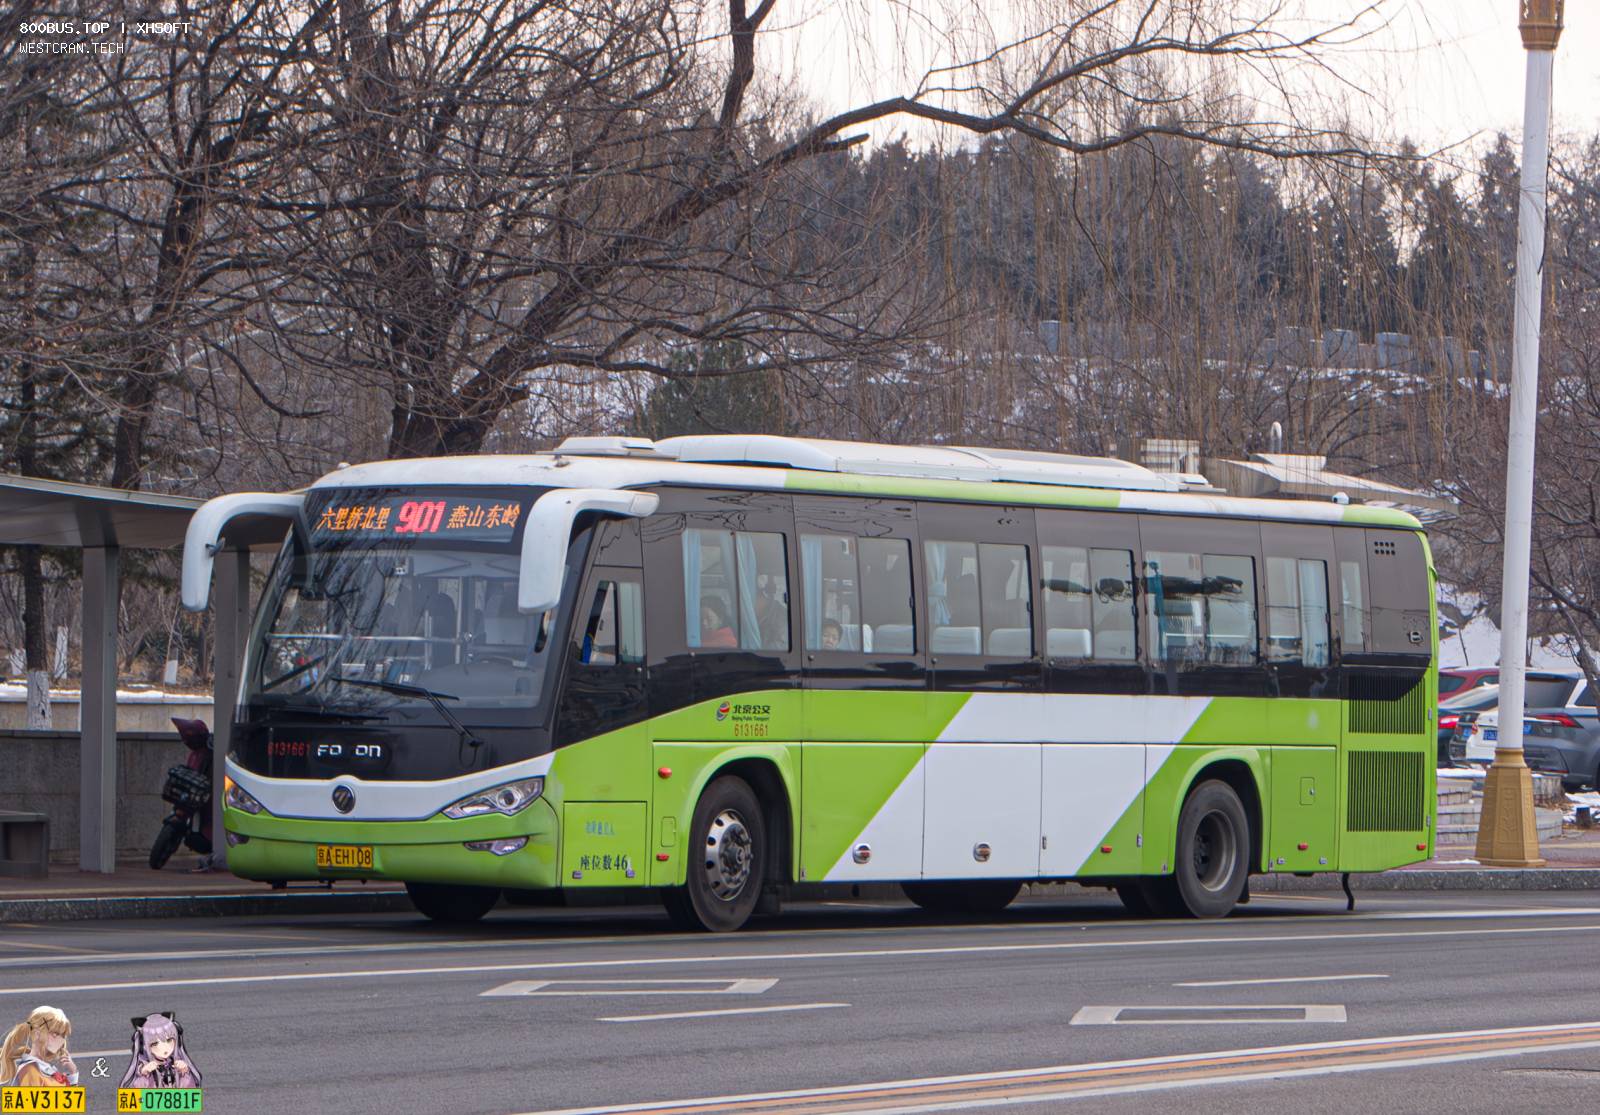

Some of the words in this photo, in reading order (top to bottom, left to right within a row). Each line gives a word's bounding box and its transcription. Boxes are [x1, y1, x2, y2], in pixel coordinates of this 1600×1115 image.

[317, 506, 391, 531] 六里桥北里
[395, 501, 446, 533] 901
[447, 503, 521, 529] 燕山东岭
[733, 704, 770, 714] 北京公交
[734, 723, 768, 736] 6131661
[267, 742, 310, 756] 6131661
